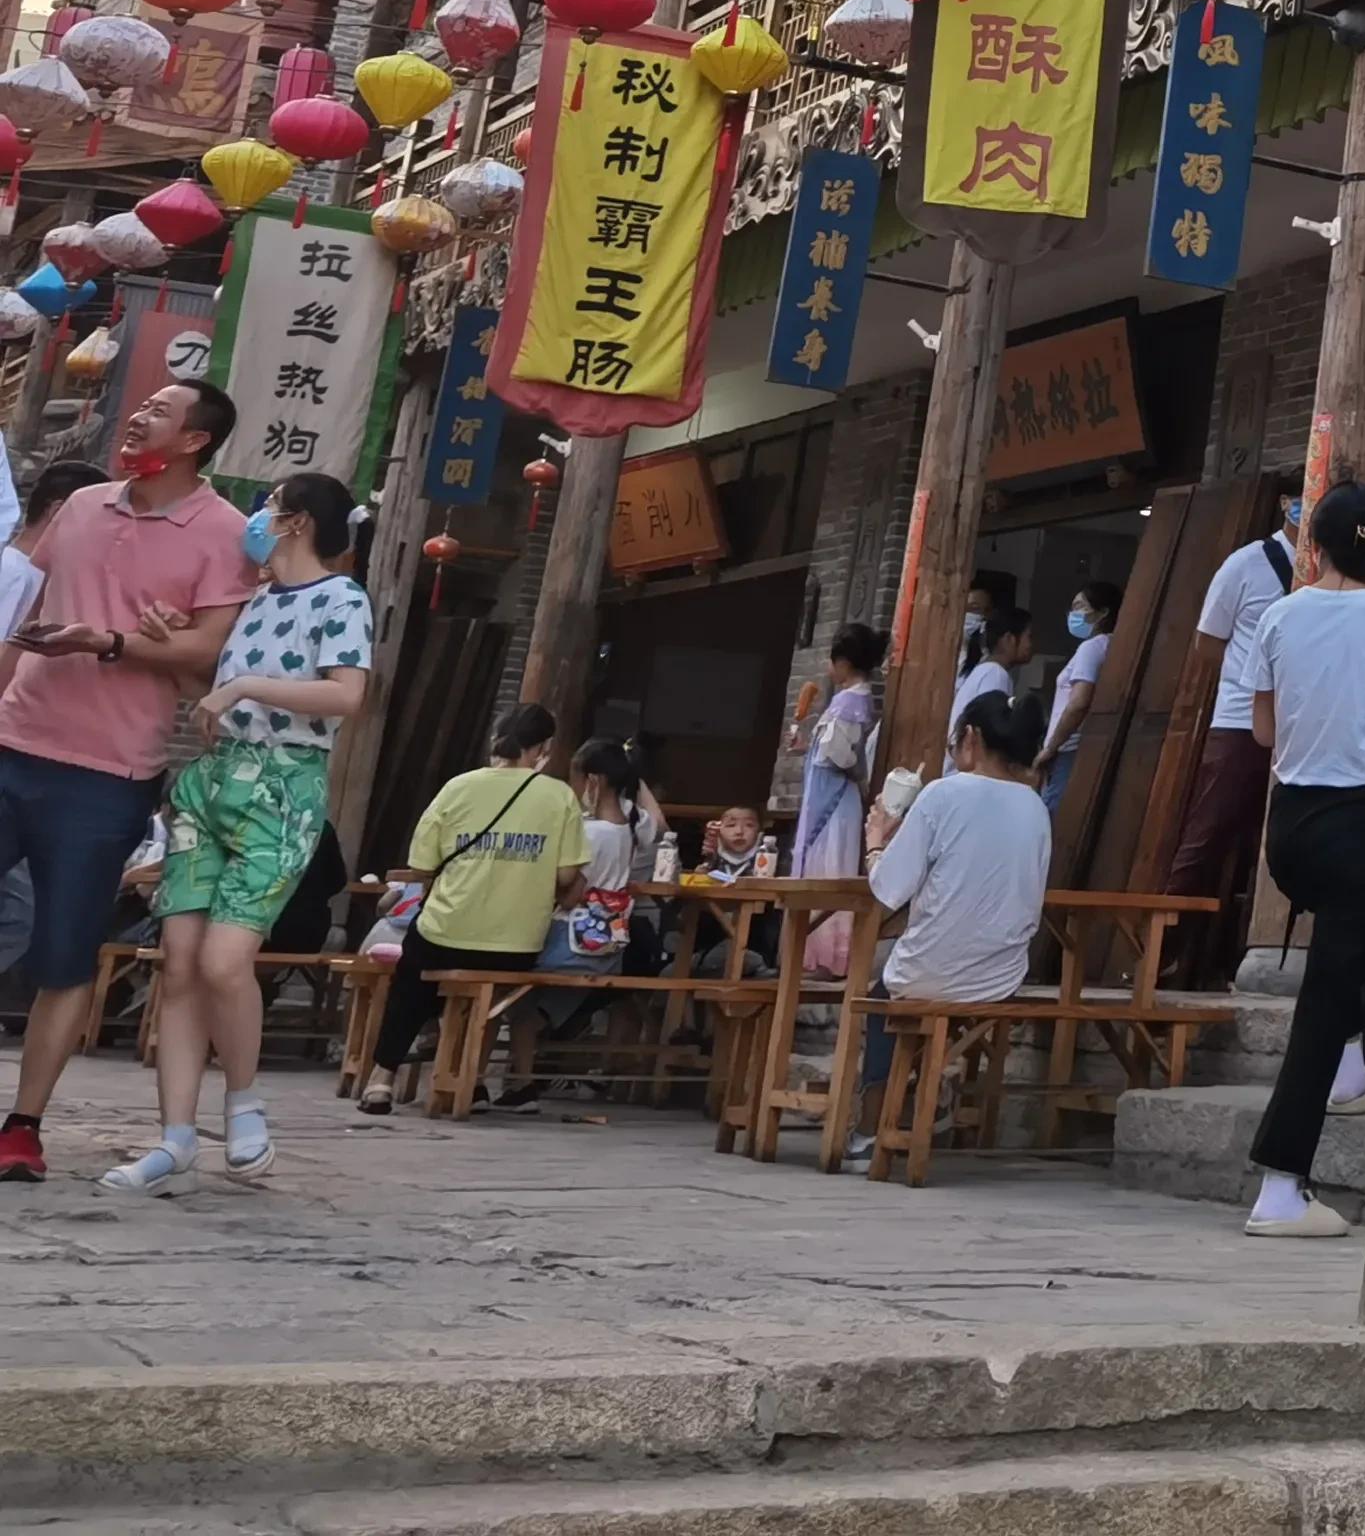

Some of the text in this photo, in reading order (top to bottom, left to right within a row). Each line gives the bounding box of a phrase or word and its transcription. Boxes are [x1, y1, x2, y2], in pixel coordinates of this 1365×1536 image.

[566, 59, 678, 390] 秘制霸王肠
[264, 240, 352, 465] 拉丝热狗
[503, 832, 548, 854] WORRY
